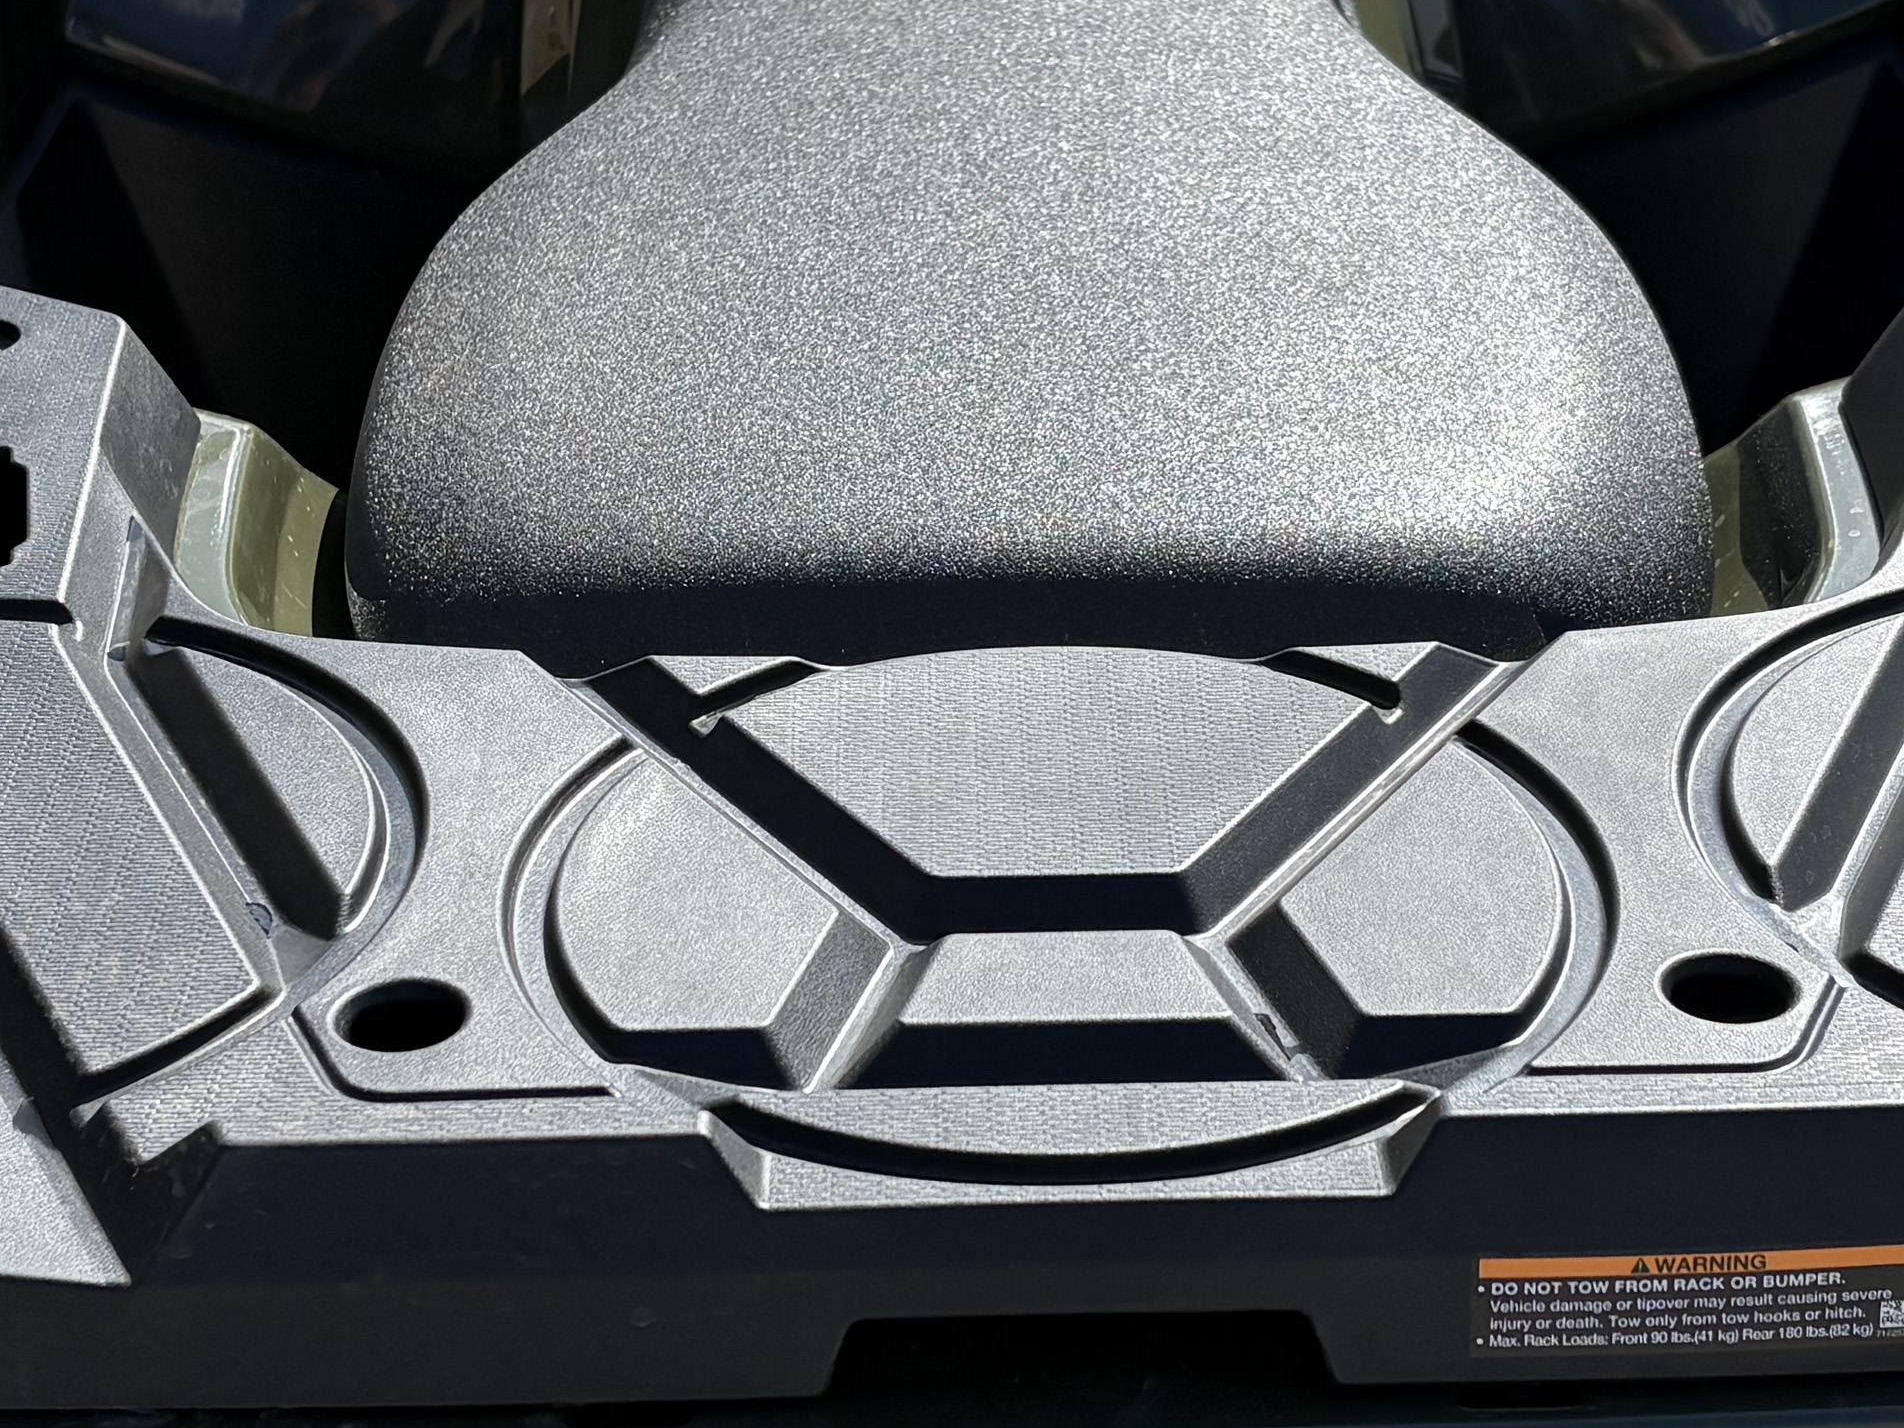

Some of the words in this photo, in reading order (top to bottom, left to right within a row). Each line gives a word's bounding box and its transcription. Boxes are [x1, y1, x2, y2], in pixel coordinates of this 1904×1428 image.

[1654, 1253, 1766, 1273] WARNING
[1490, 1281, 1518, 1296] DO
[1523, 1280, 1563, 1296] NOT
[1569, 1279, 1614, 1295] TOW
[1614, 1278, 1668, 1293] FROM
[1673, 1276, 1725, 1291] RACK
[1730, 1274, 1757, 1289] OR
[1762, 1271, 1846, 1288] BUMPER.
[1489, 1298, 1546, 1314] Vehicle
[1549, 1297, 1612, 1315] damage
[1616, 1299, 1633, 1311] or
[1636, 1296, 1690, 1313] tipover
[1693, 1296, 1726, 1311] may
[1730, 1292, 1773, 1307] result
[1777, 1290, 1837, 1307] causing
[1841, 1288, 1893, 1302] severe
[1489, 1314, 1531, 1332] injury
[1535, 1317, 1552, 1330] or
[1555, 1314, 1603, 1330] death.
[1608, 1313, 1641, 1328] Tow
[1644, 1313, 1678, 1329] only
[1681, 1311, 1717, 1326] from
[1721, 1311, 1749, 1325] tow
[1753, 1309, 1800, 1323] hooks
[1804, 1310, 1822, 1321] or
[1824, 1305, 1866, 1320] hitch.
[1488, 1333, 1520, 1348] Max.
[1523, 1332, 1559, 1347] Rack
[1562, 1331, 1608, 1347] Loads:
[1611, 1330, 1648, 1345] Front
[1650, 1330, 1668, 1344] 90
[1717, 1328, 1739, 1345] kg)
[1741, 1327, 1775, 1341] Rear
[1778, 1325, 1803, 1340] 180
[1852, 1322, 1874, 1338] kg)
